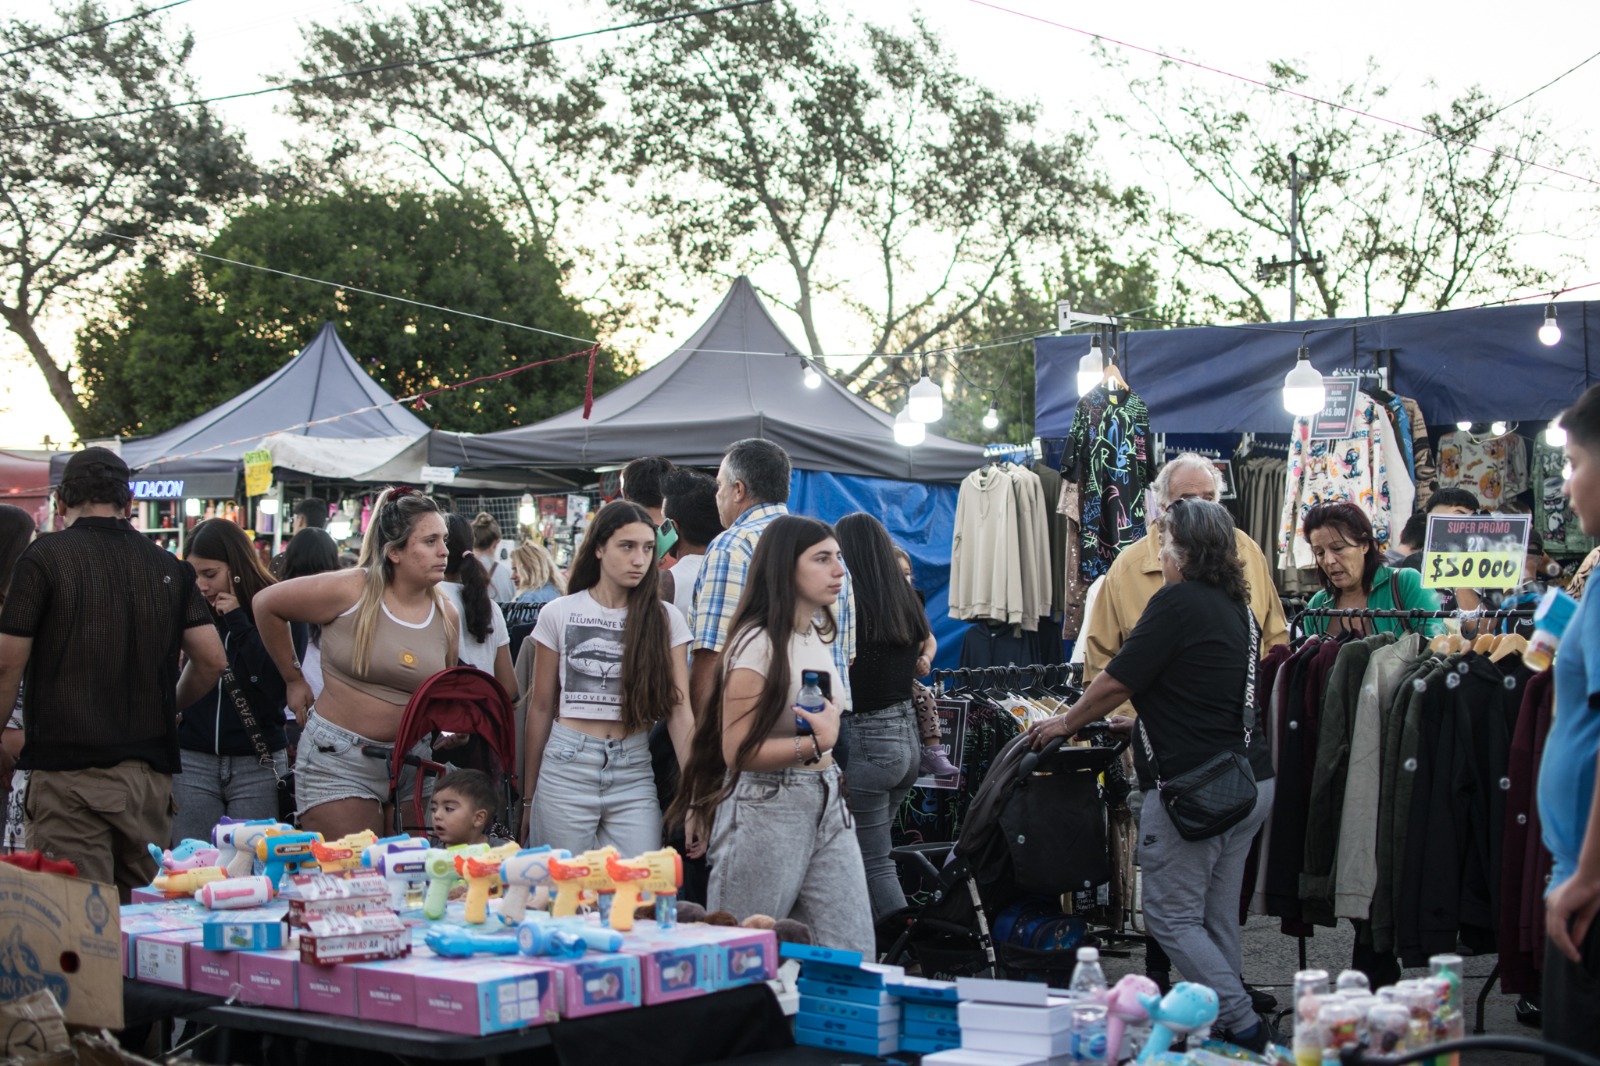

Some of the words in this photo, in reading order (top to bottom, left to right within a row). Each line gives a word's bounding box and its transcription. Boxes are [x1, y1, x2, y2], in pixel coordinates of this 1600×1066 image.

[1448, 522, 1476, 534] SUPER
[1477, 522, 1510, 534] PROMO
[1467, 536, 1483, 552] 2X
[570, 616, 617, 628] ILLUMINATE
[231, 688, 256, 728] LOVE
[348, 941, 368, 950] PILAS
[370, 940, 379, 948] AA
